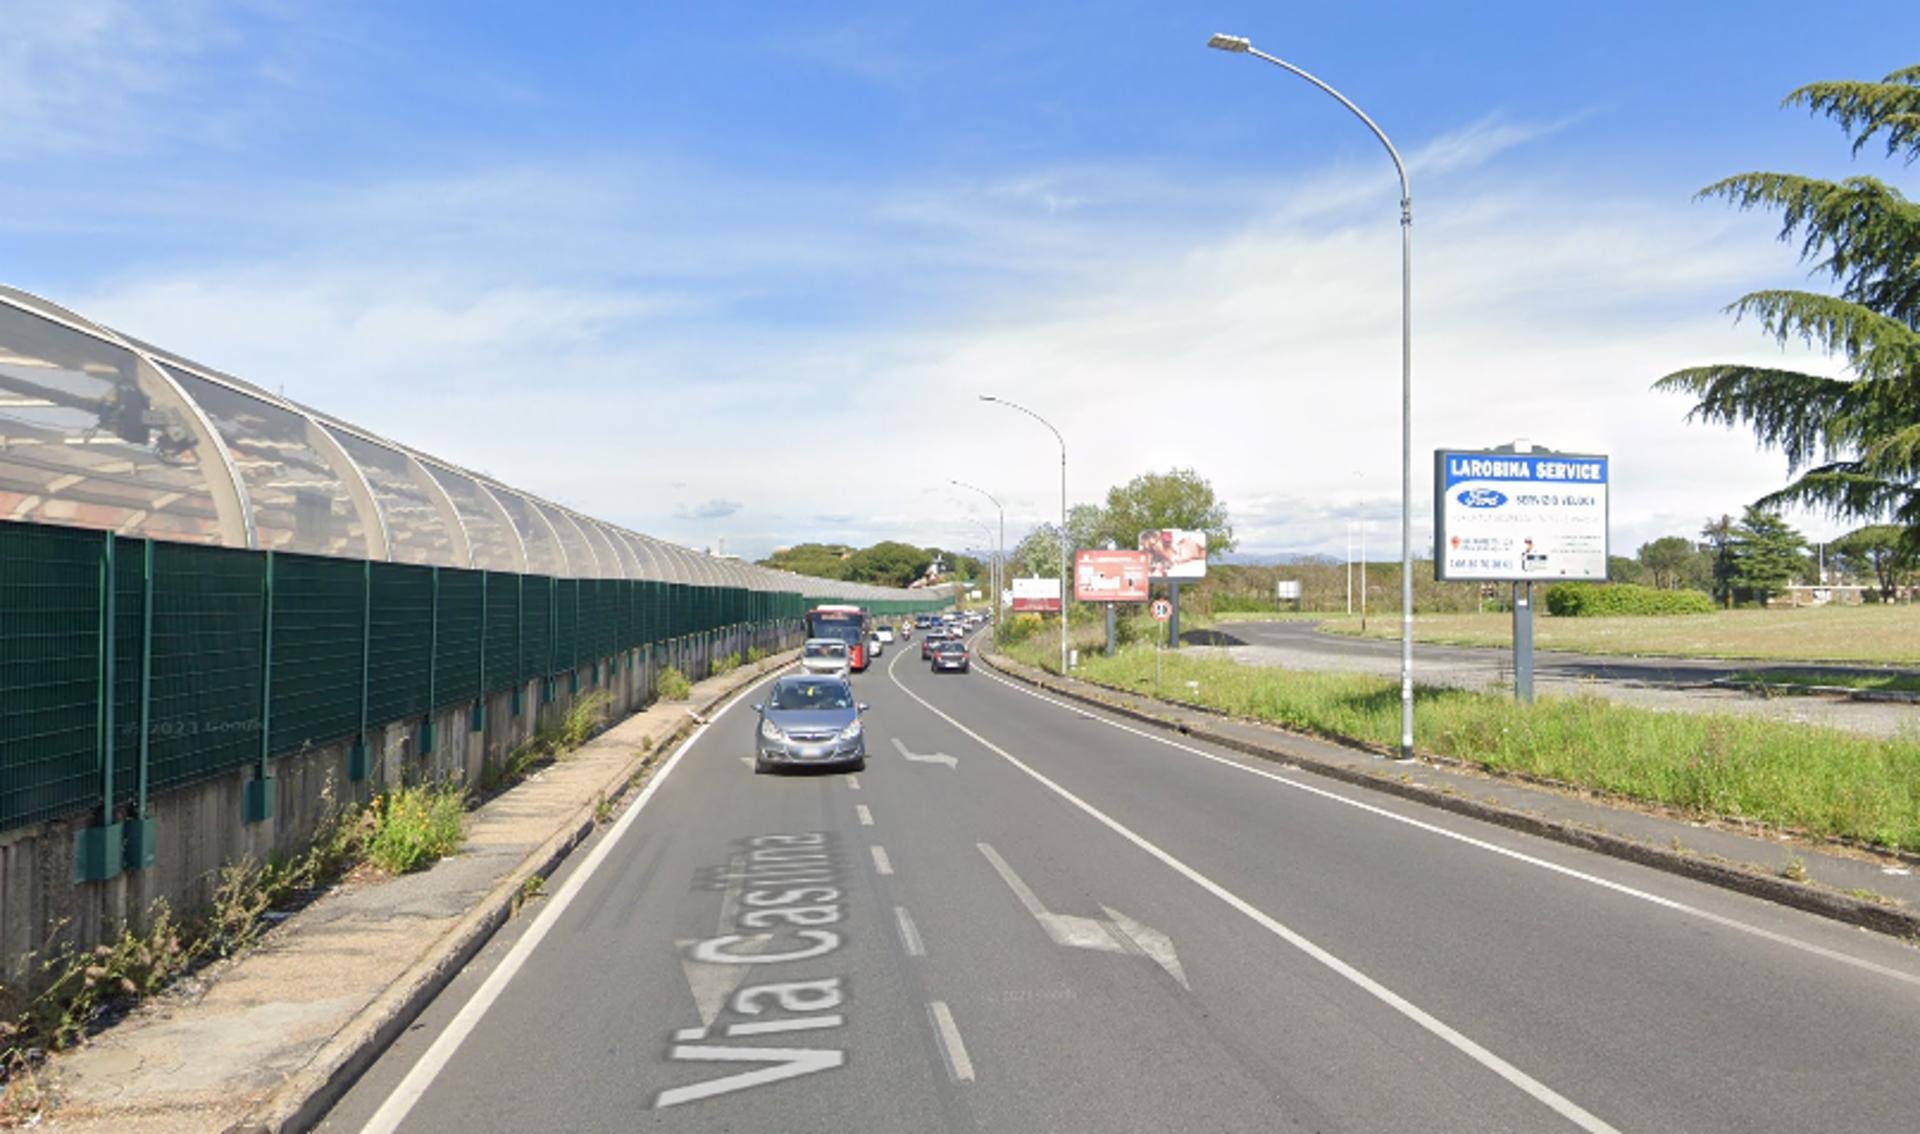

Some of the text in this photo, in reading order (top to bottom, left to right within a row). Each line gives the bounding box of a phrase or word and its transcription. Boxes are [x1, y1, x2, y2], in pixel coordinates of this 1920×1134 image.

[1451, 459, 1601, 480] LAROBINA SERVICE
[1462, 489, 1502, 508] Ford
